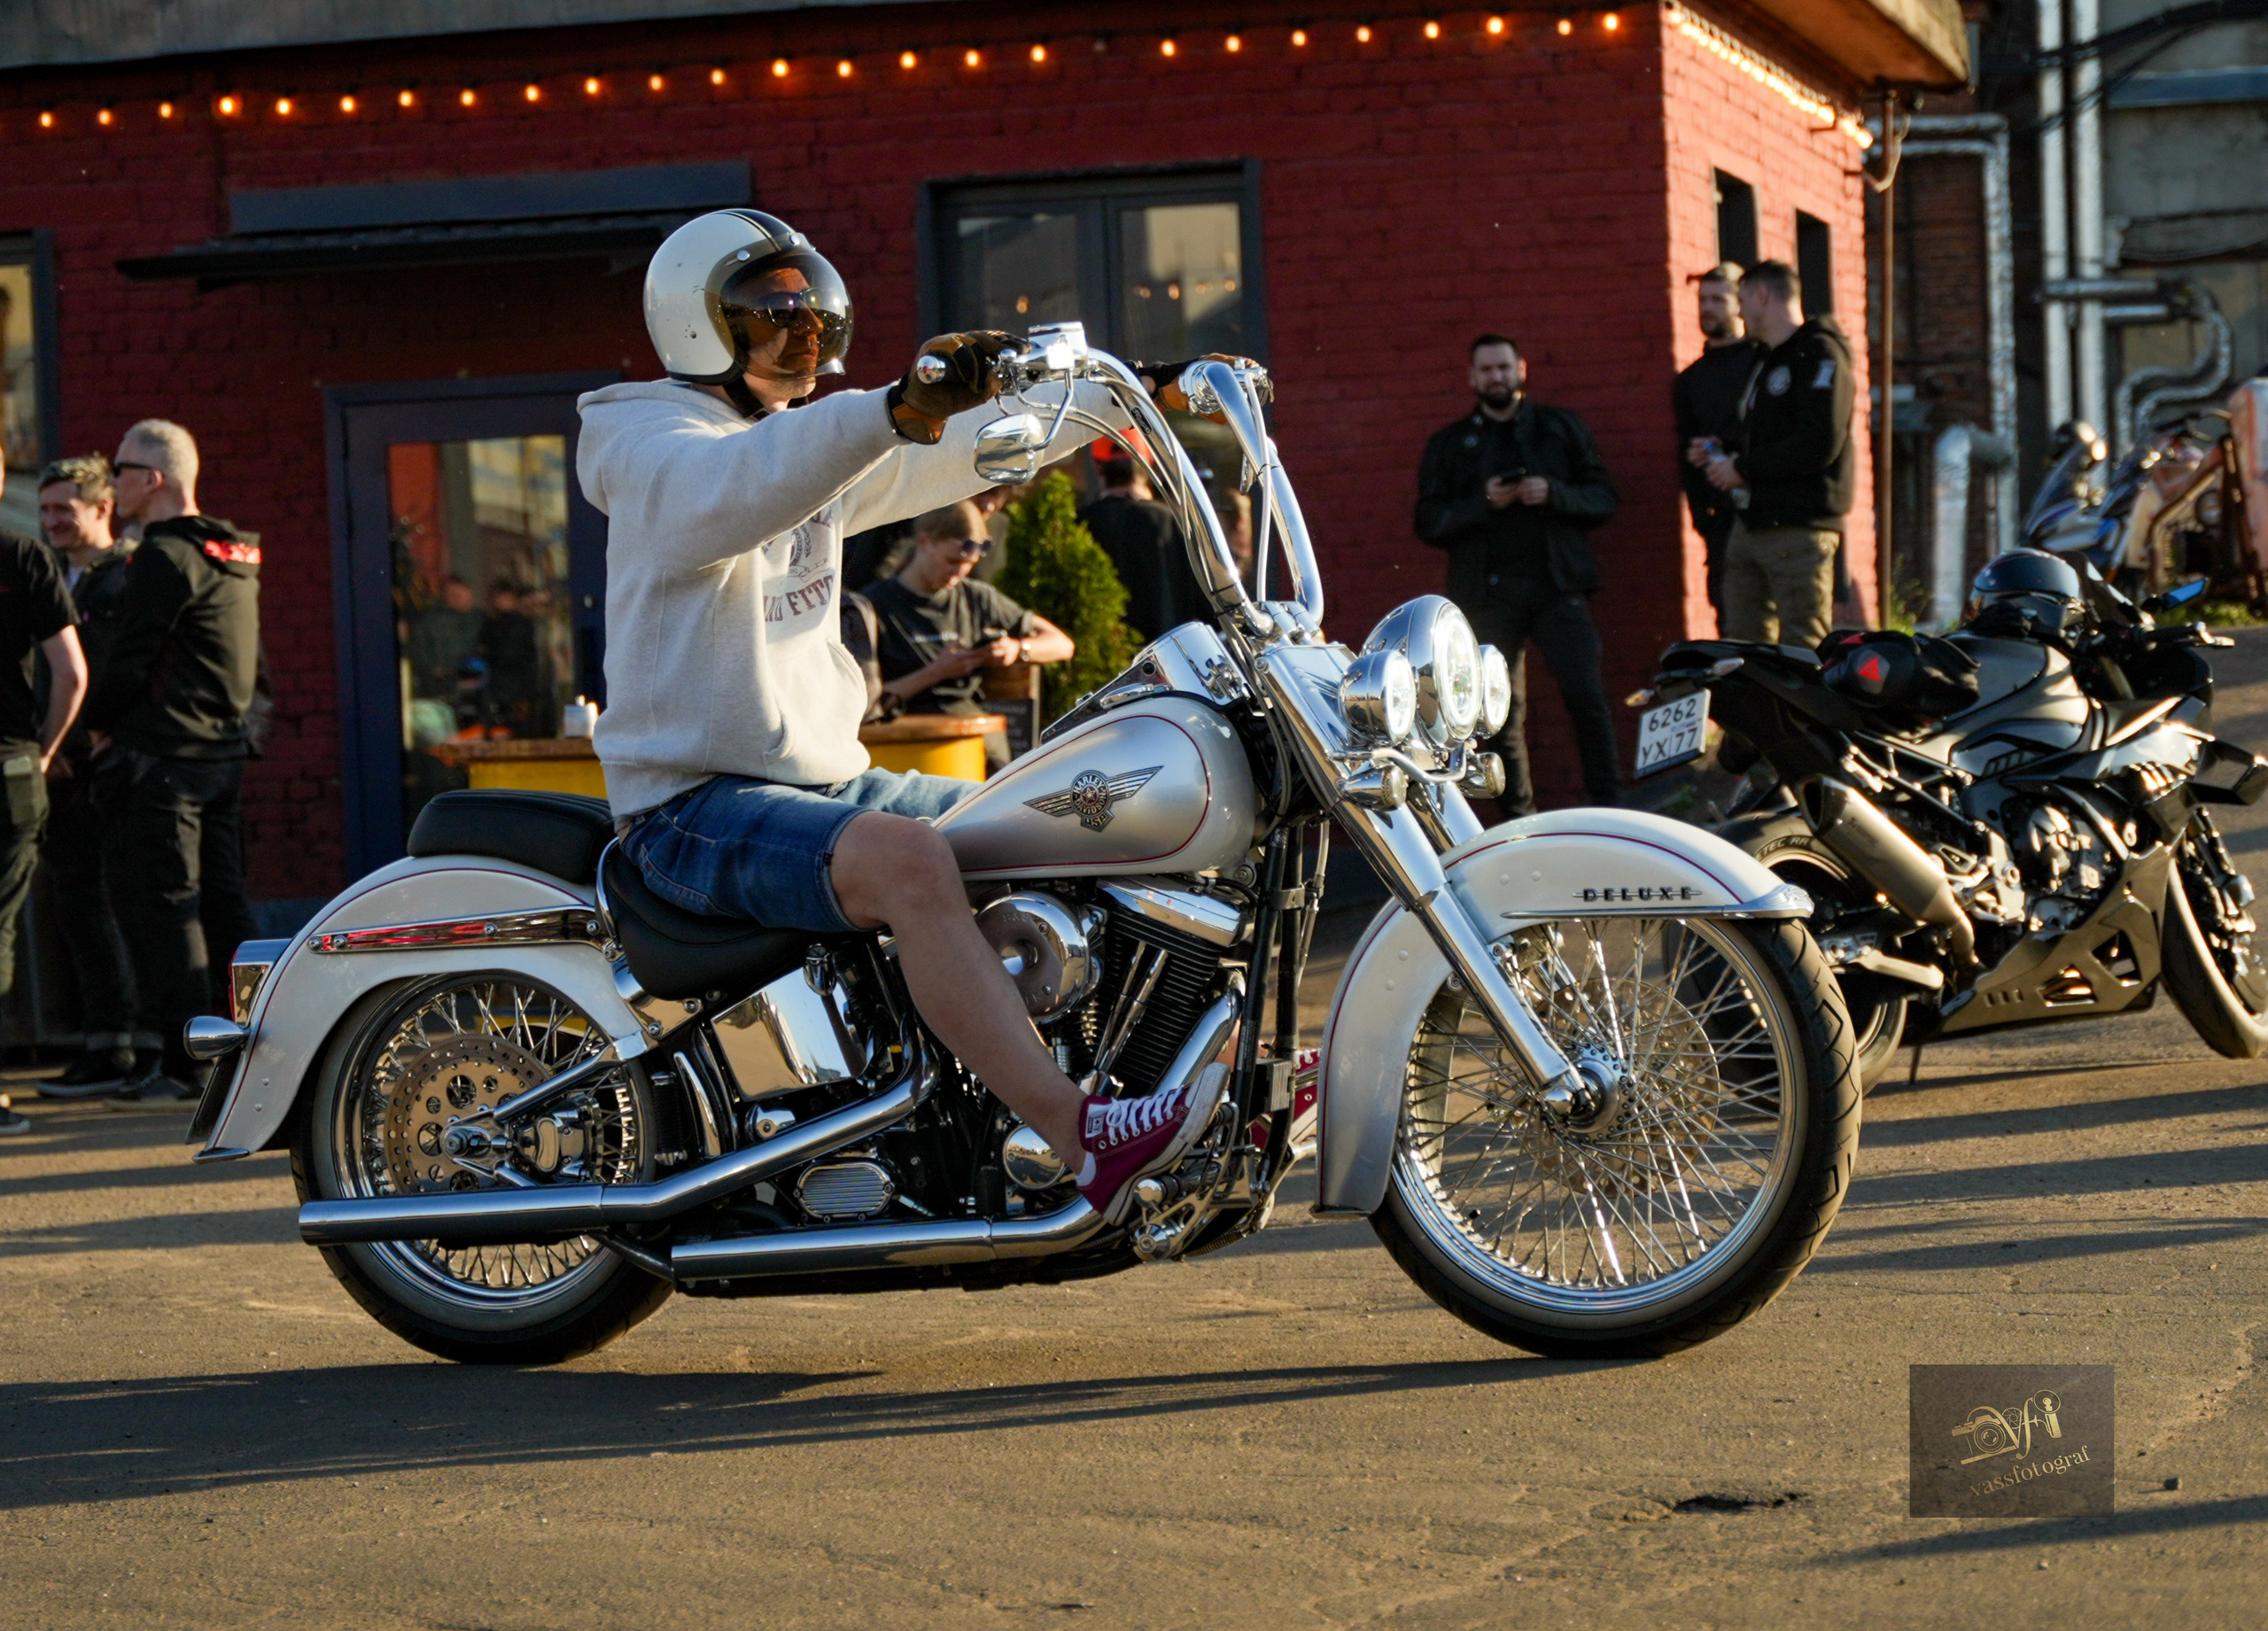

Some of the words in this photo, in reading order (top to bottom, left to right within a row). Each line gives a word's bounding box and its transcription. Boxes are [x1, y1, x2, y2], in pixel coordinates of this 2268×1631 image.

[1649, 698, 1697, 733] 6262
[1675, 727, 1698, 753] 77
[1074, 792, 1107, 814] DAVIDSON
[1084, 813, 1107, 827] USA
[1755, 837, 1787, 861] ETEC
[1583, 887, 1692, 902] DELUXE
